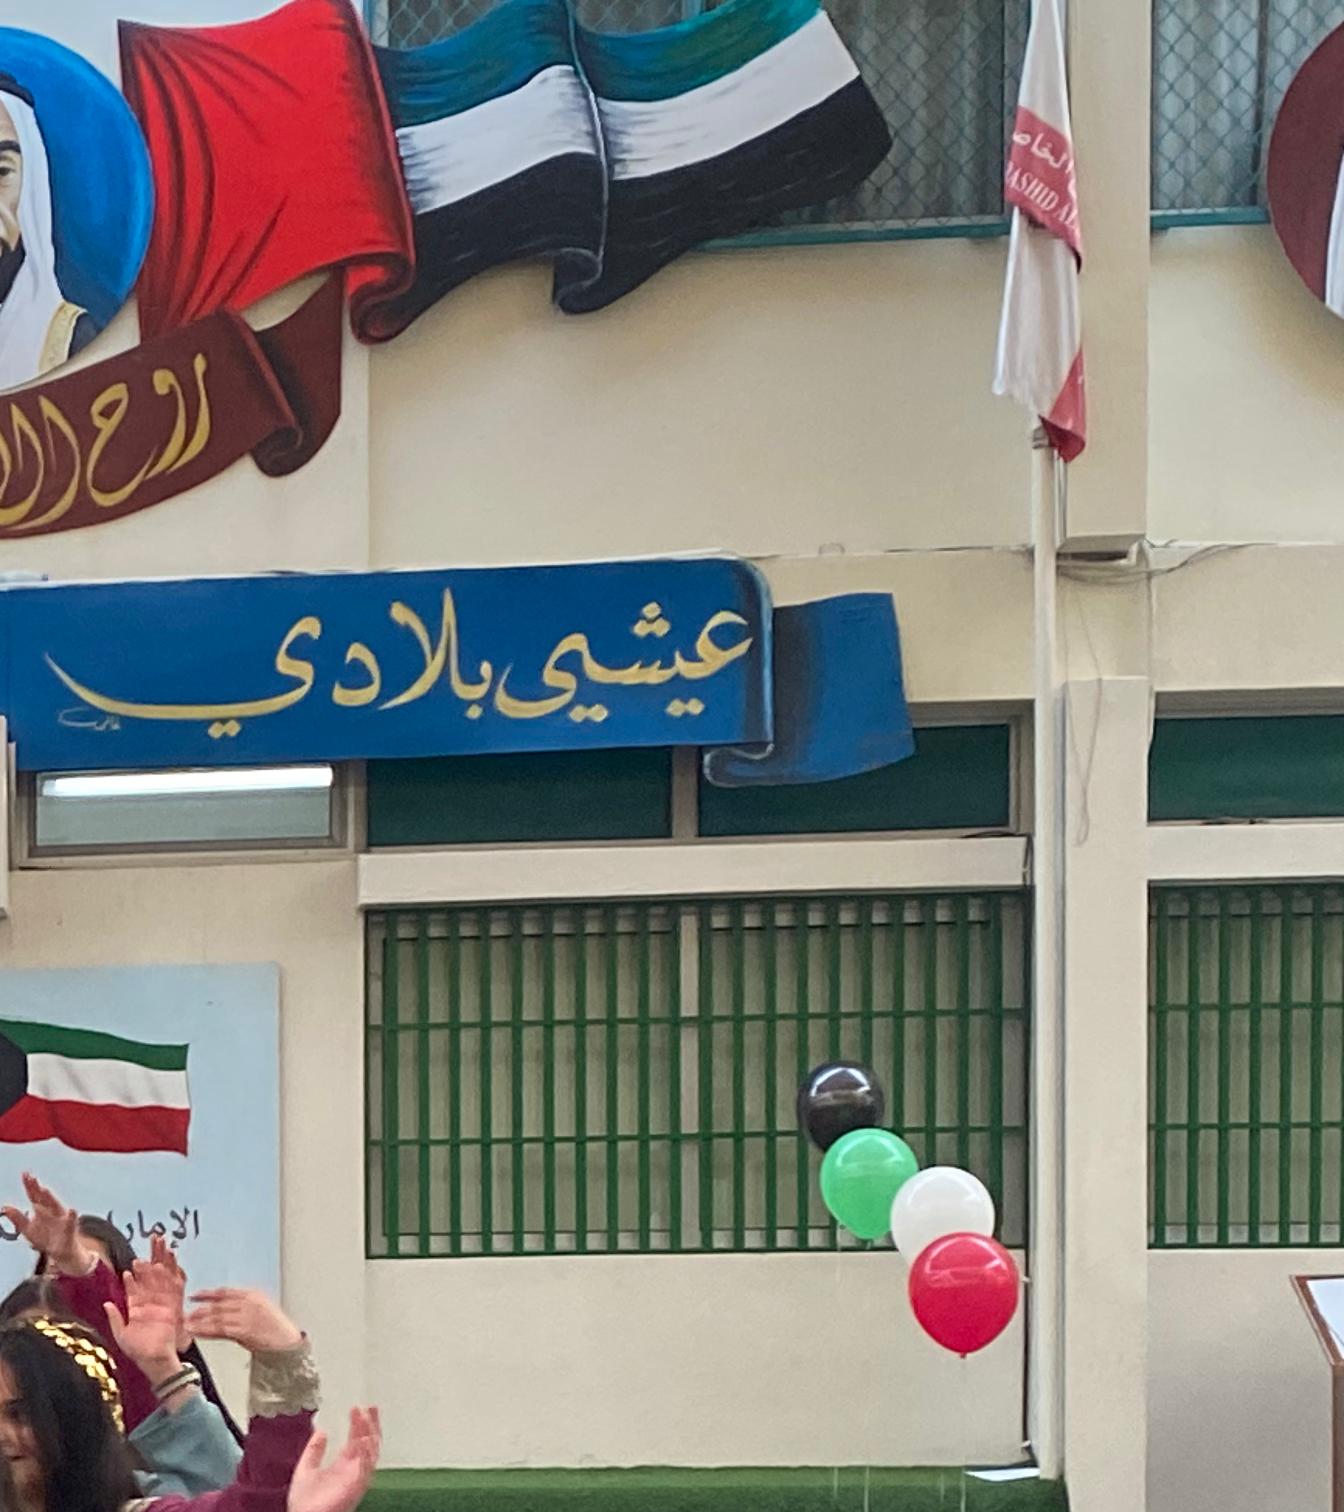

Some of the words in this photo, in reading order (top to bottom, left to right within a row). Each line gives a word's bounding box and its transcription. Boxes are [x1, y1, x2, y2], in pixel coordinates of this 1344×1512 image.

[87, 353, 211, 506] روح
[43, 588, 494, 738] بلادي
[494, 601, 754, 723] عيشي
